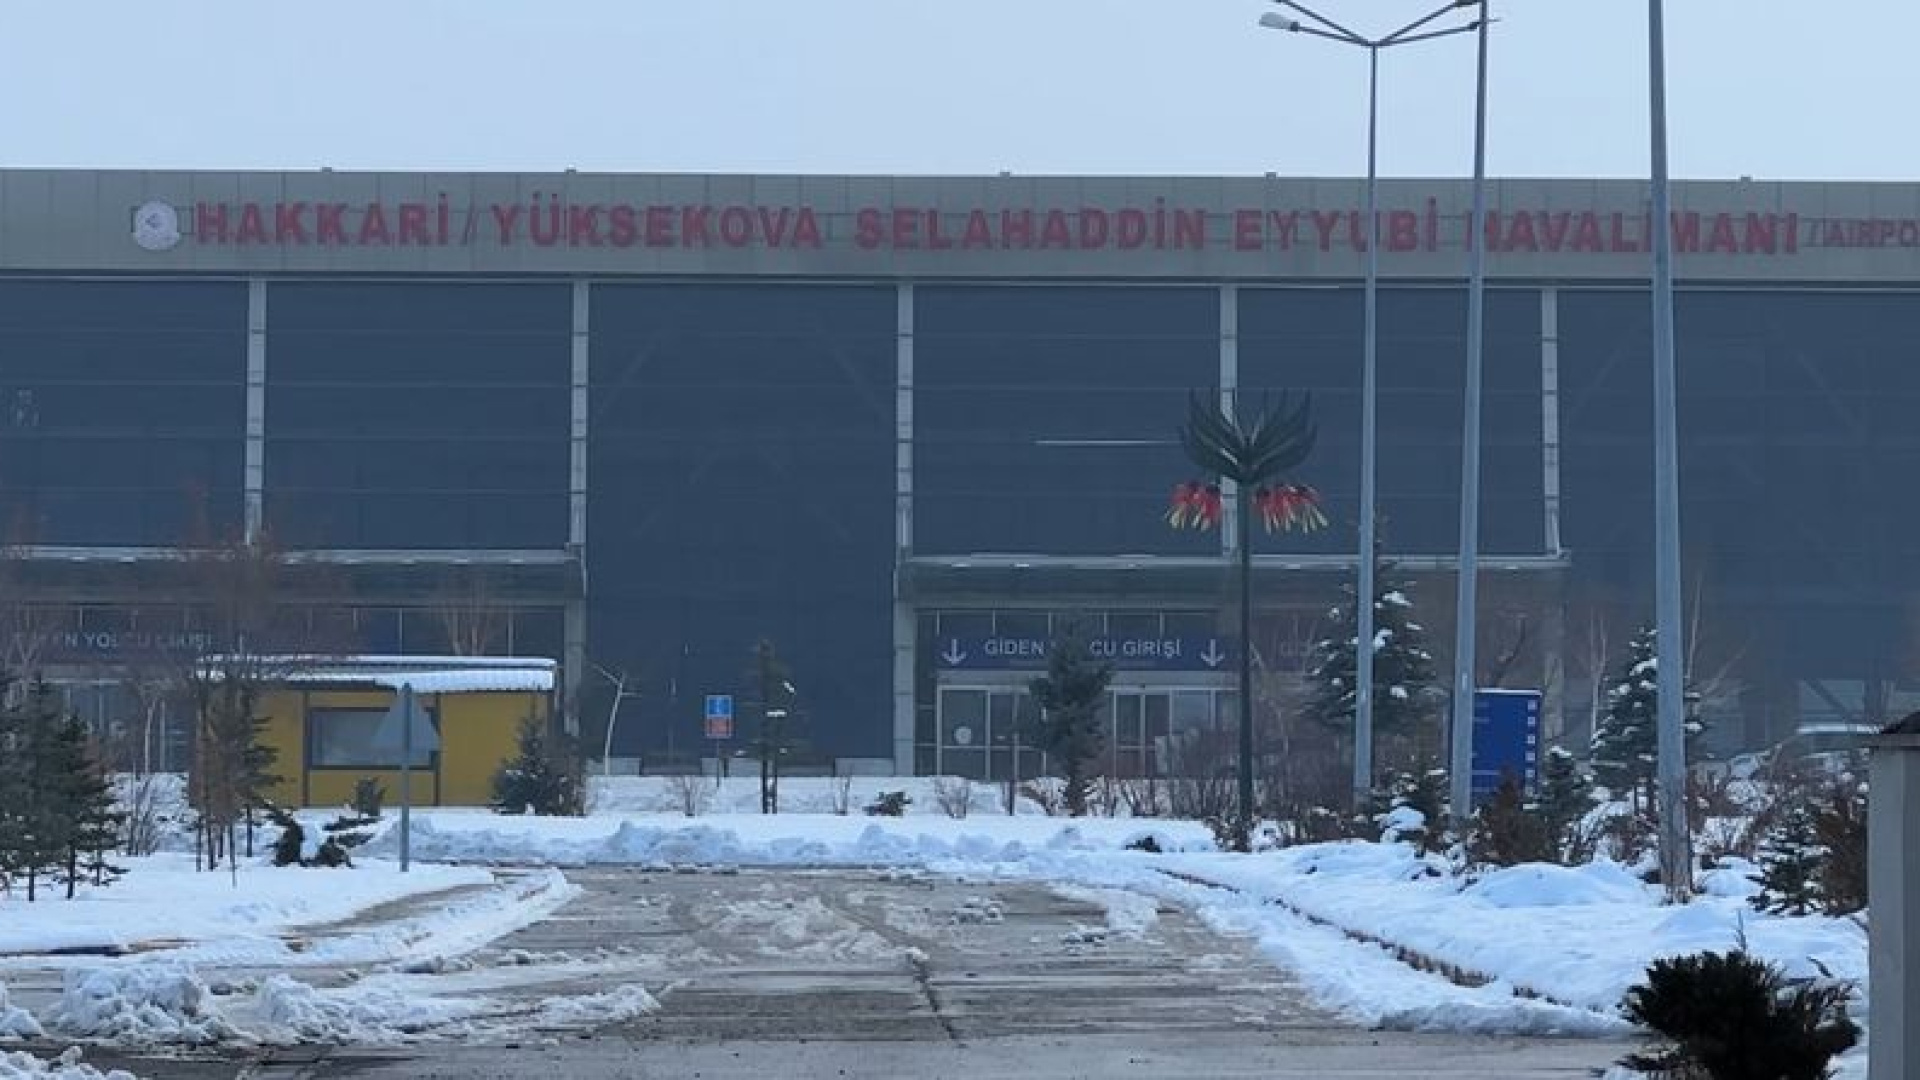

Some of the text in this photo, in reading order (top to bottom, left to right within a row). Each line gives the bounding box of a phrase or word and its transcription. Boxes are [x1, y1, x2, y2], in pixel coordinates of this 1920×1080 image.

[855, 198, 1206, 250] SELAHADDİN
[1235, 197, 1437, 251] EYYUBİ
[984, 637, 1045, 656] GİDEN
